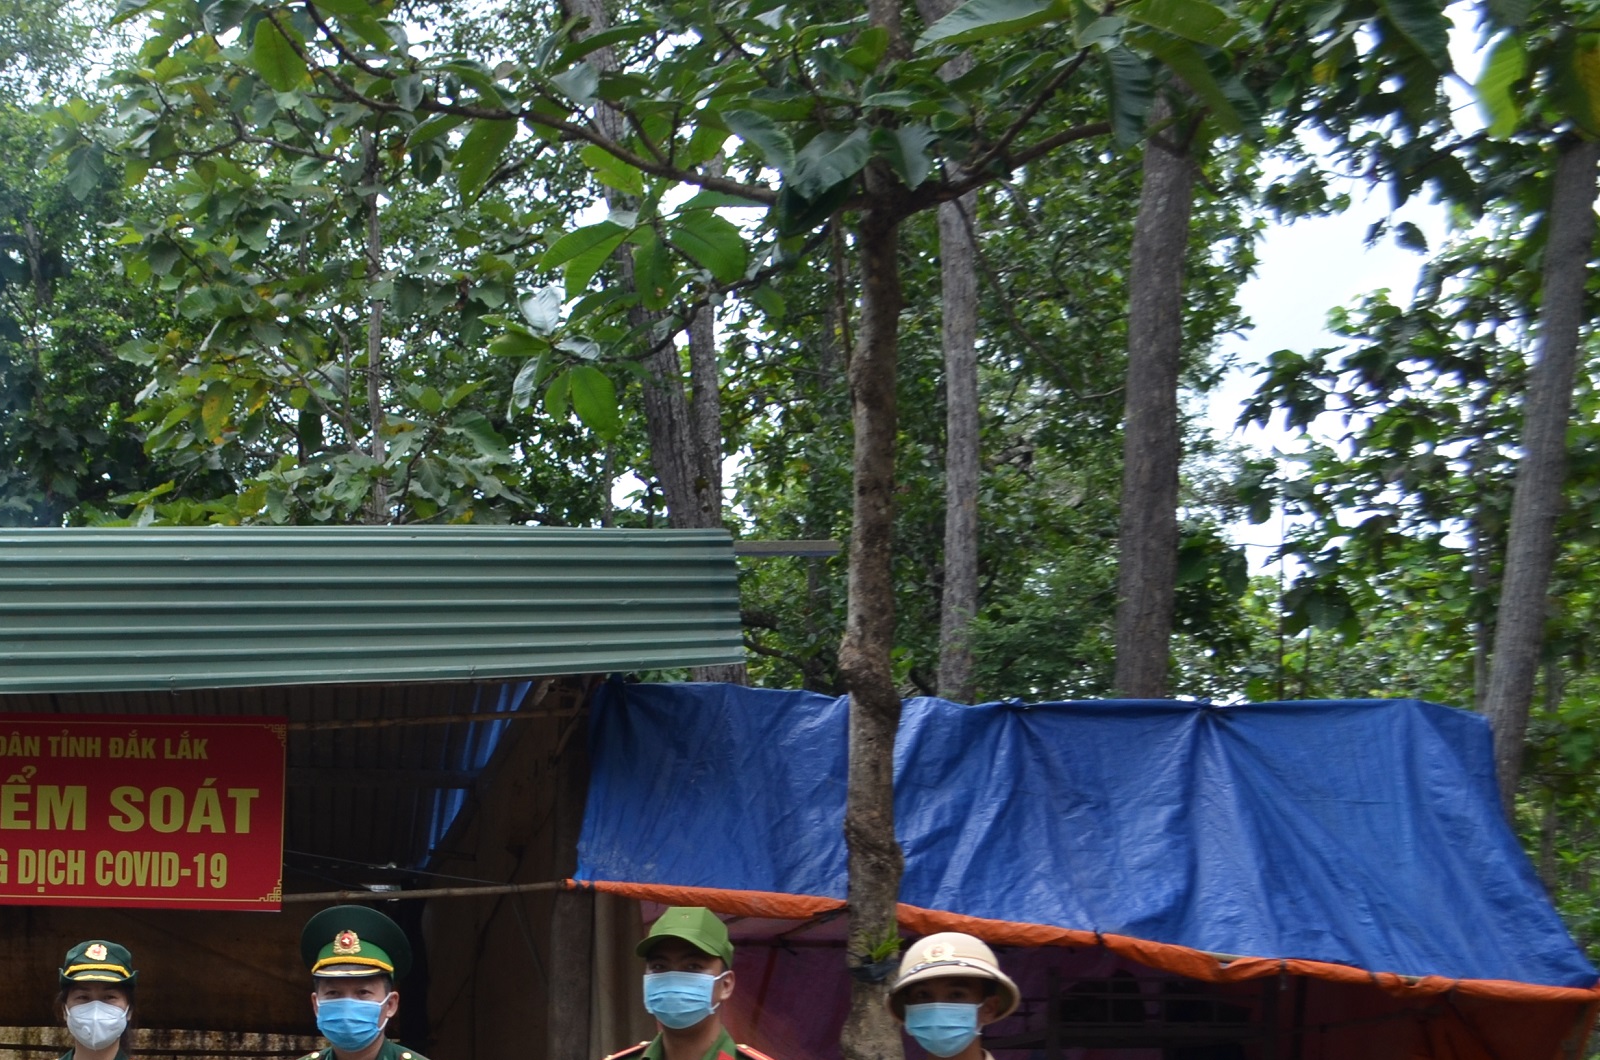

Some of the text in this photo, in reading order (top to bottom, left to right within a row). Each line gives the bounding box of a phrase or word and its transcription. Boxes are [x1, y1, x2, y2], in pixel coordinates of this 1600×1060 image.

[48, 729, 102, 758] TỈNH
[109, 729, 156, 759] ĐẮK
[164, 730, 208, 760] LẮK
[108, 777, 259, 833] SOÁT
[17, 848, 86, 893] DỊCH
[95, 850, 228, 889] COVID-19
